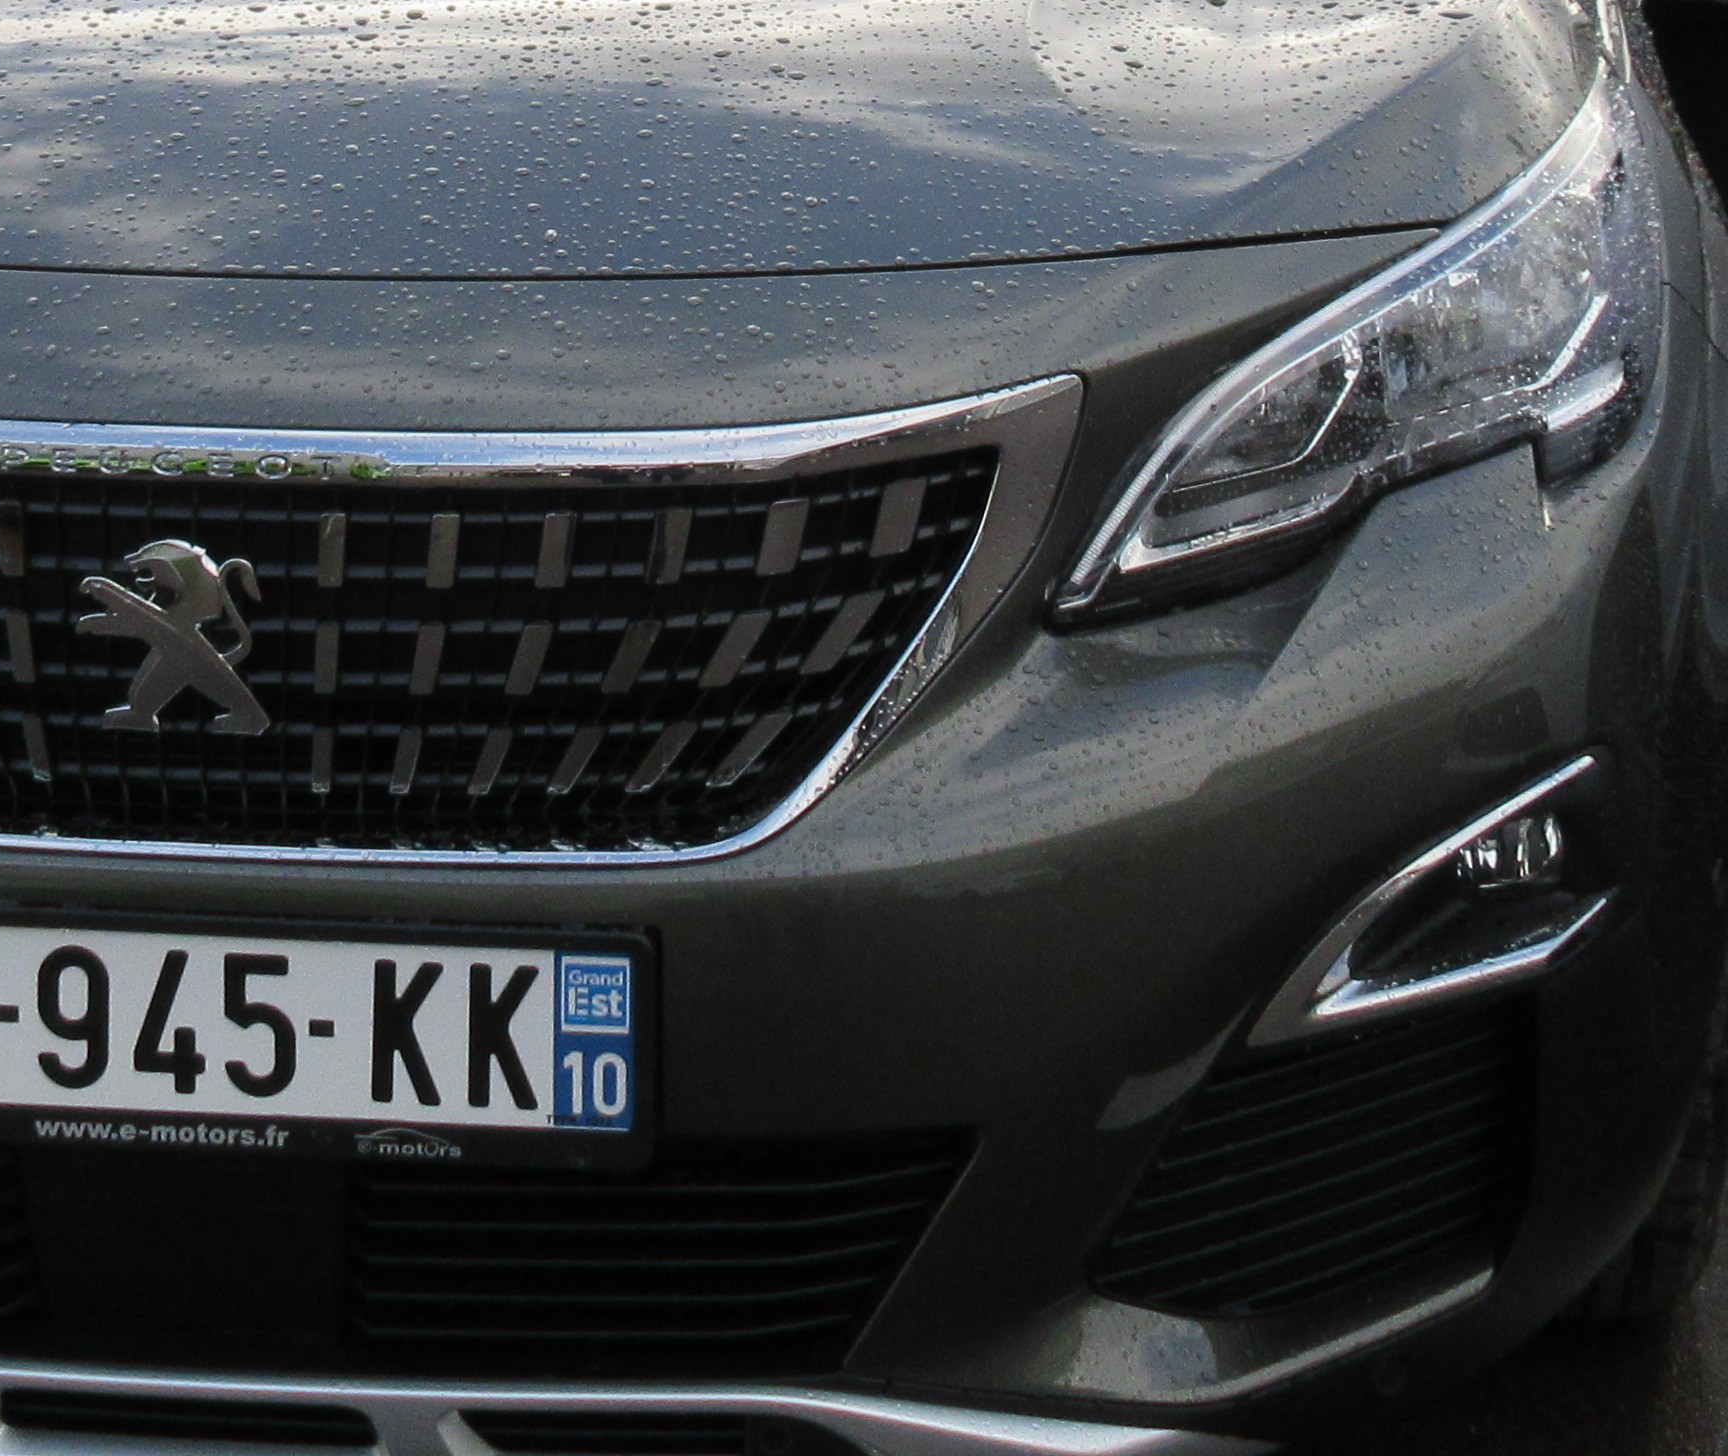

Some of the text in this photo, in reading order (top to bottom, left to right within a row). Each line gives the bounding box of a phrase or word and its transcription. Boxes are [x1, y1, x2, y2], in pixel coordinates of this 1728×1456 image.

[569, 969, 624, 987] Grand
[568, 987, 624, 1018] Est
[564, 1051, 627, 1116] 10
[34, 1120, 290, 1146] www.e-motors.fr
